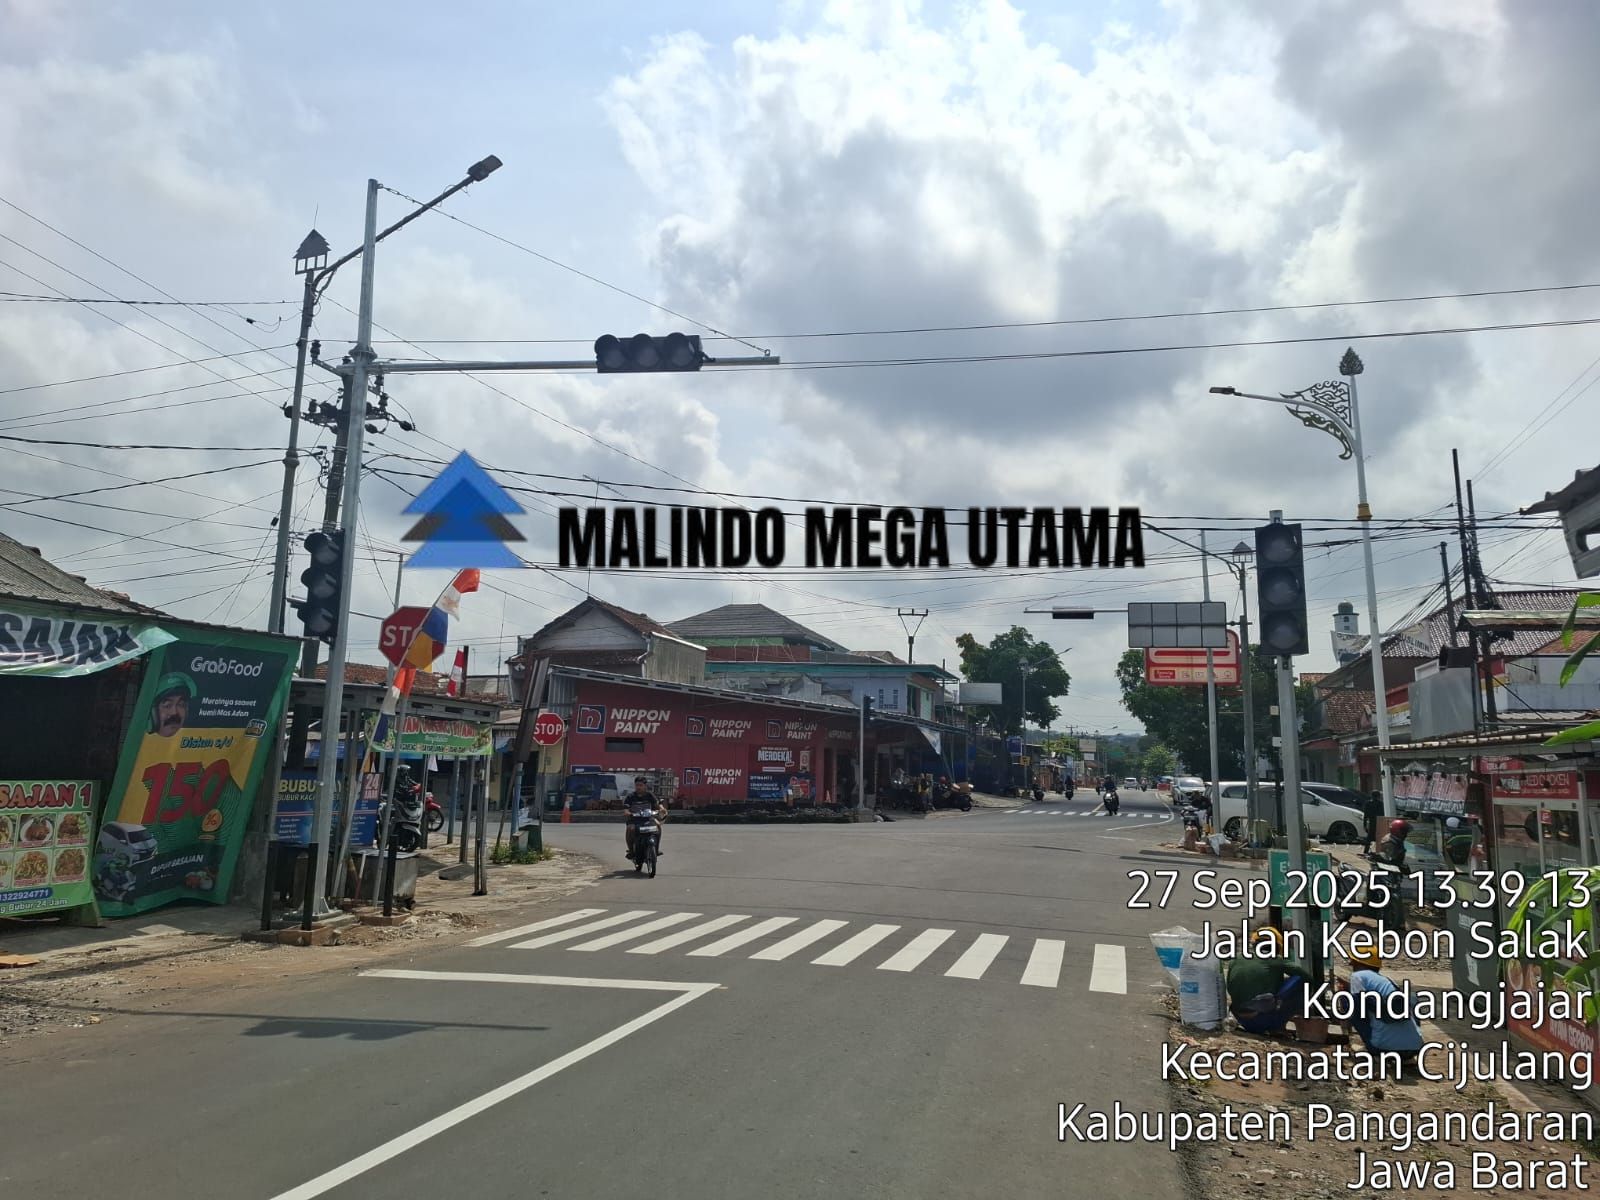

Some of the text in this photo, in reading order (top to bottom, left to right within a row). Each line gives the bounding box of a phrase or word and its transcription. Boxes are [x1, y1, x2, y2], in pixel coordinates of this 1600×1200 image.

[190, 656, 263, 677] GrabFood
[610, 708, 671, 722] NIPPON
[533, 723, 563, 736] STOP
[614, 722, 661, 734] PAINT
[709, 719, 752, 729] NIPPON
[712, 729, 745, 738] PAINT
[787, 732, 812, 740] PAINT
[757, 749, 793, 763] MERDEKA!
[704, 768, 742, 777] NIPPON
[366, 773, 381, 789] 24
[706, 776, 737, 785] PAINT
[80, 782, 93, 807] 1
[141, 758, 231, 825] 150
